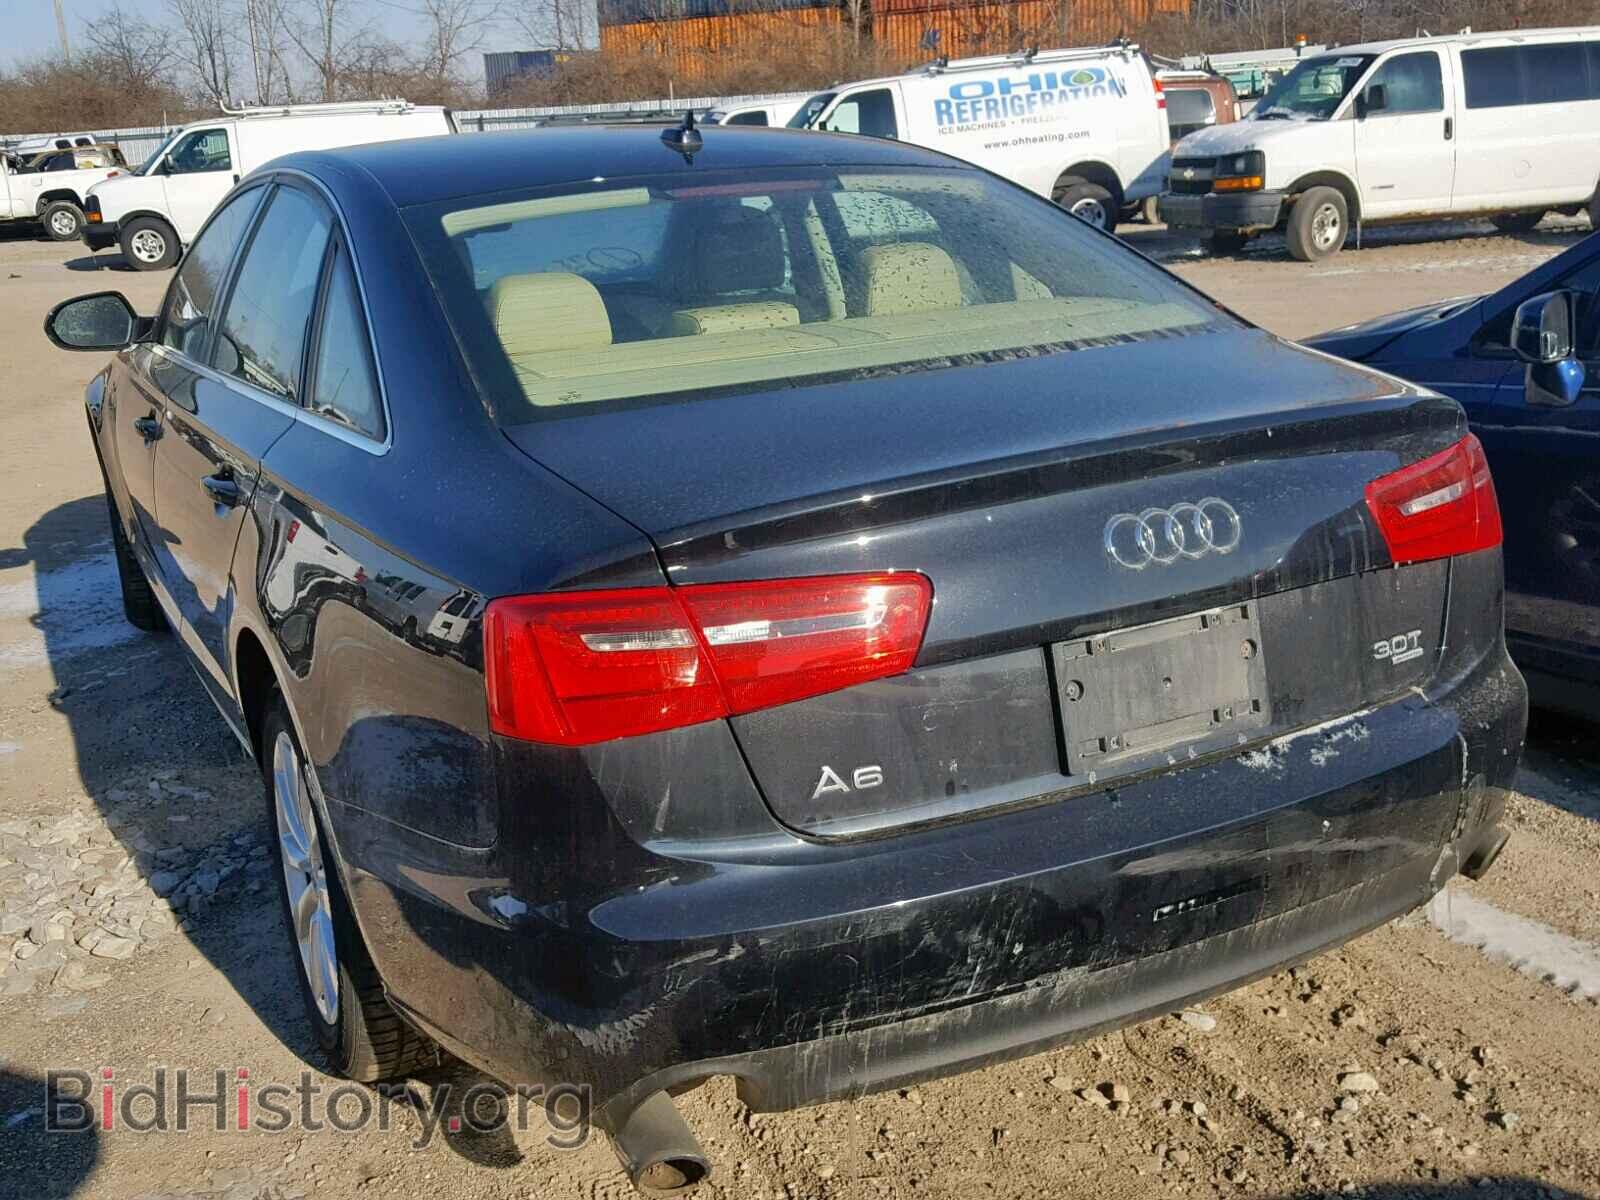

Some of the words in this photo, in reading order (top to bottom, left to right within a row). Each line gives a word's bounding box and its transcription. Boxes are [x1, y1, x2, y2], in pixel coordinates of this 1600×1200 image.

[949, 67, 1105, 100] OHIO
[934, 79, 1127, 126] REFRIGERATION
[938, 125, 955, 136] ICE
[957, 120, 1006, 134] MACHINES
[984, 130, 1090, 150] www.ohheating.com
[812, 765, 883, 800] A6
